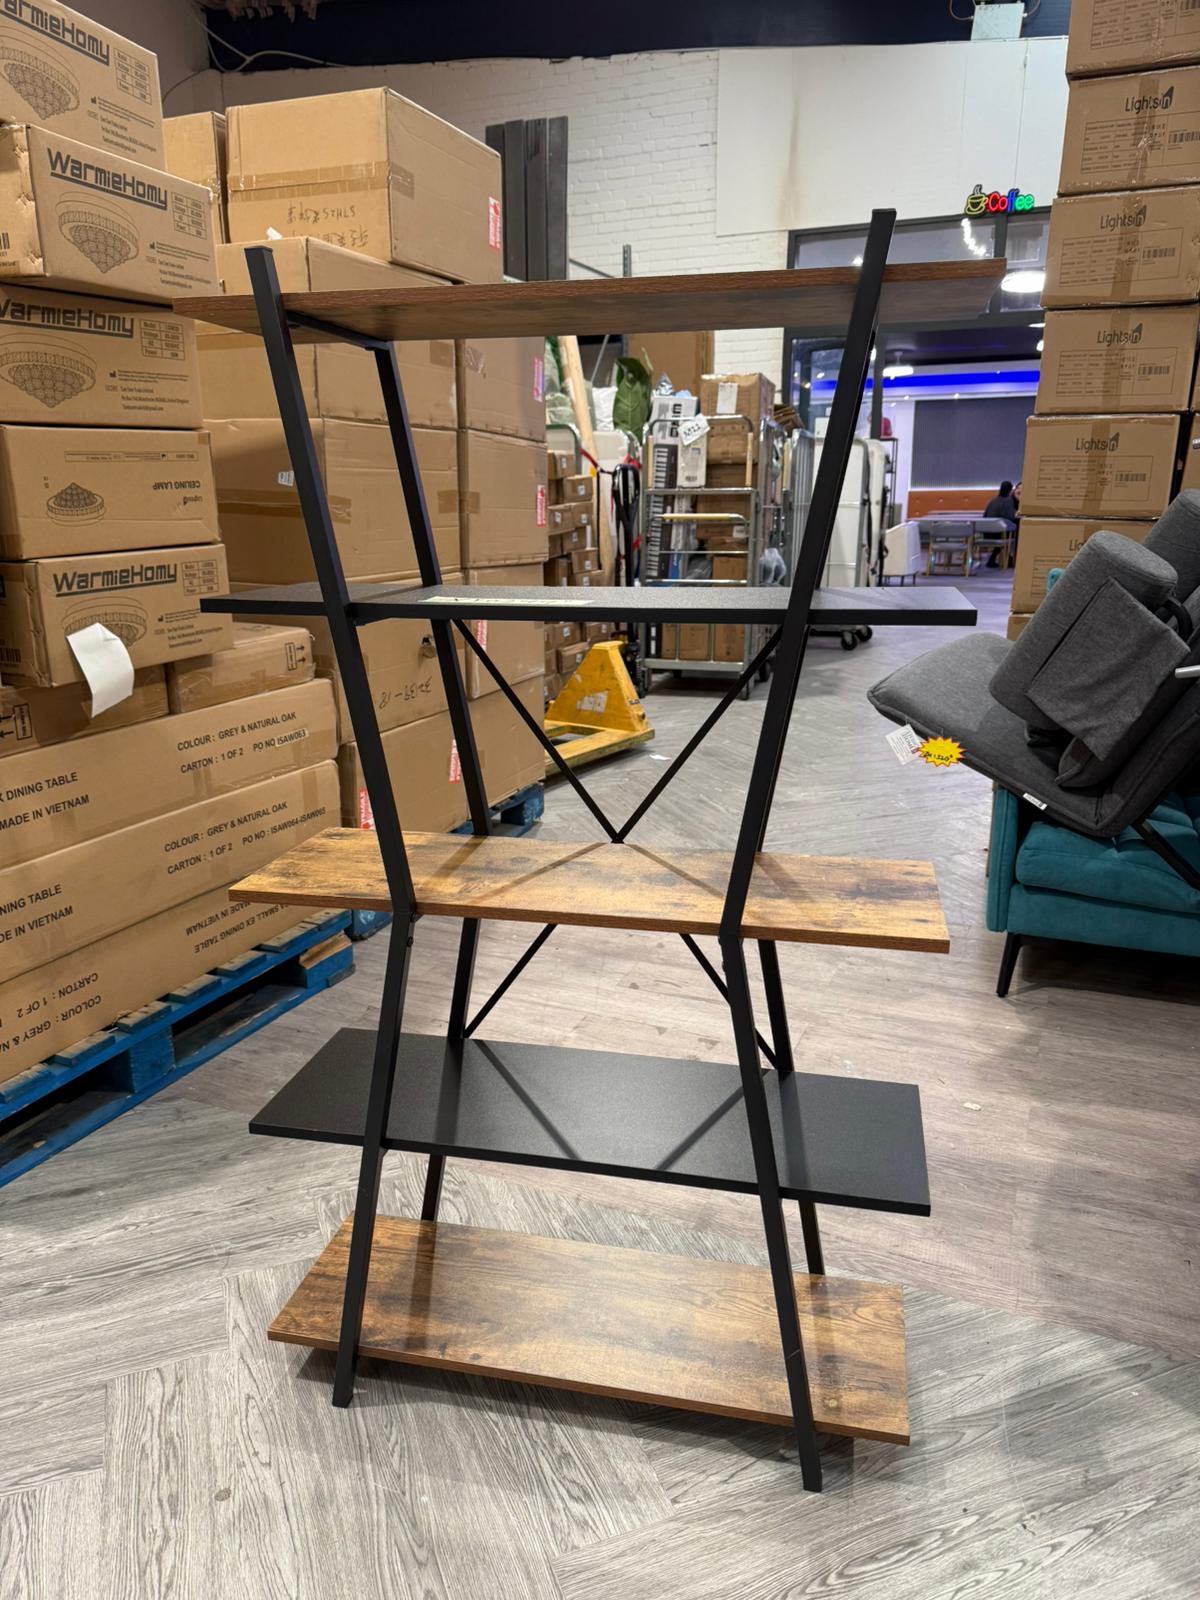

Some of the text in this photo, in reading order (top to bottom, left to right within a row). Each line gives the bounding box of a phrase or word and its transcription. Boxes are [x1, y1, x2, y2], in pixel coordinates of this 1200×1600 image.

[4, 0, 109, 62] armieHomy
[47, 148, 168, 207] WarmieHomy
[988, 188, 1035, 213] Coffee
[152, 480, 201, 491] CEILING LAMP
[53, 563, 178, 592] WarmieHomy
[218, 727, 239, 740] GREY
[240, 726, 247, 734] &
[247, 716, 280, 731] NATURAL
[281, 712, 297, 722] OAK
[227, 749, 238, 759] OF
[239, 747, 244, 756] 2
[253, 742, 264, 752] PO
[264, 738, 275, 749] NO
[6, 782, 44, 801] DINING
[45, 771, 79, 789] TABLE
[0, 794, 90, 831] MADE IN VIETNAM
[207, 822, 229, 838] GREY
[230, 819, 236, 829] &
[237, 807, 271, 826] NATURAL
[271, 801, 288, 813] OAK
[215, 844, 227, 856] OF
[228, 842, 233, 851] 2
[242, 835, 253, 846] PO
[254, 830, 266, 841] NO
[0, 884, 62, 916] NING TABLE
[0, 905, 74, 944] DE IN VIETNAM
[185, 913, 221, 936] VIETNAM
[220, 908, 230, 918] IN
[246, 917, 256, 927] EX
[219, 921, 246, 940] DINING
[194, 936, 219, 954] TABLE
[16, 1008, 24, 1018] 2
[25, 1000, 40, 1015] OF
[12, 1036, 20, 1046] &
[23, 1020, 51, 1042] GREY
